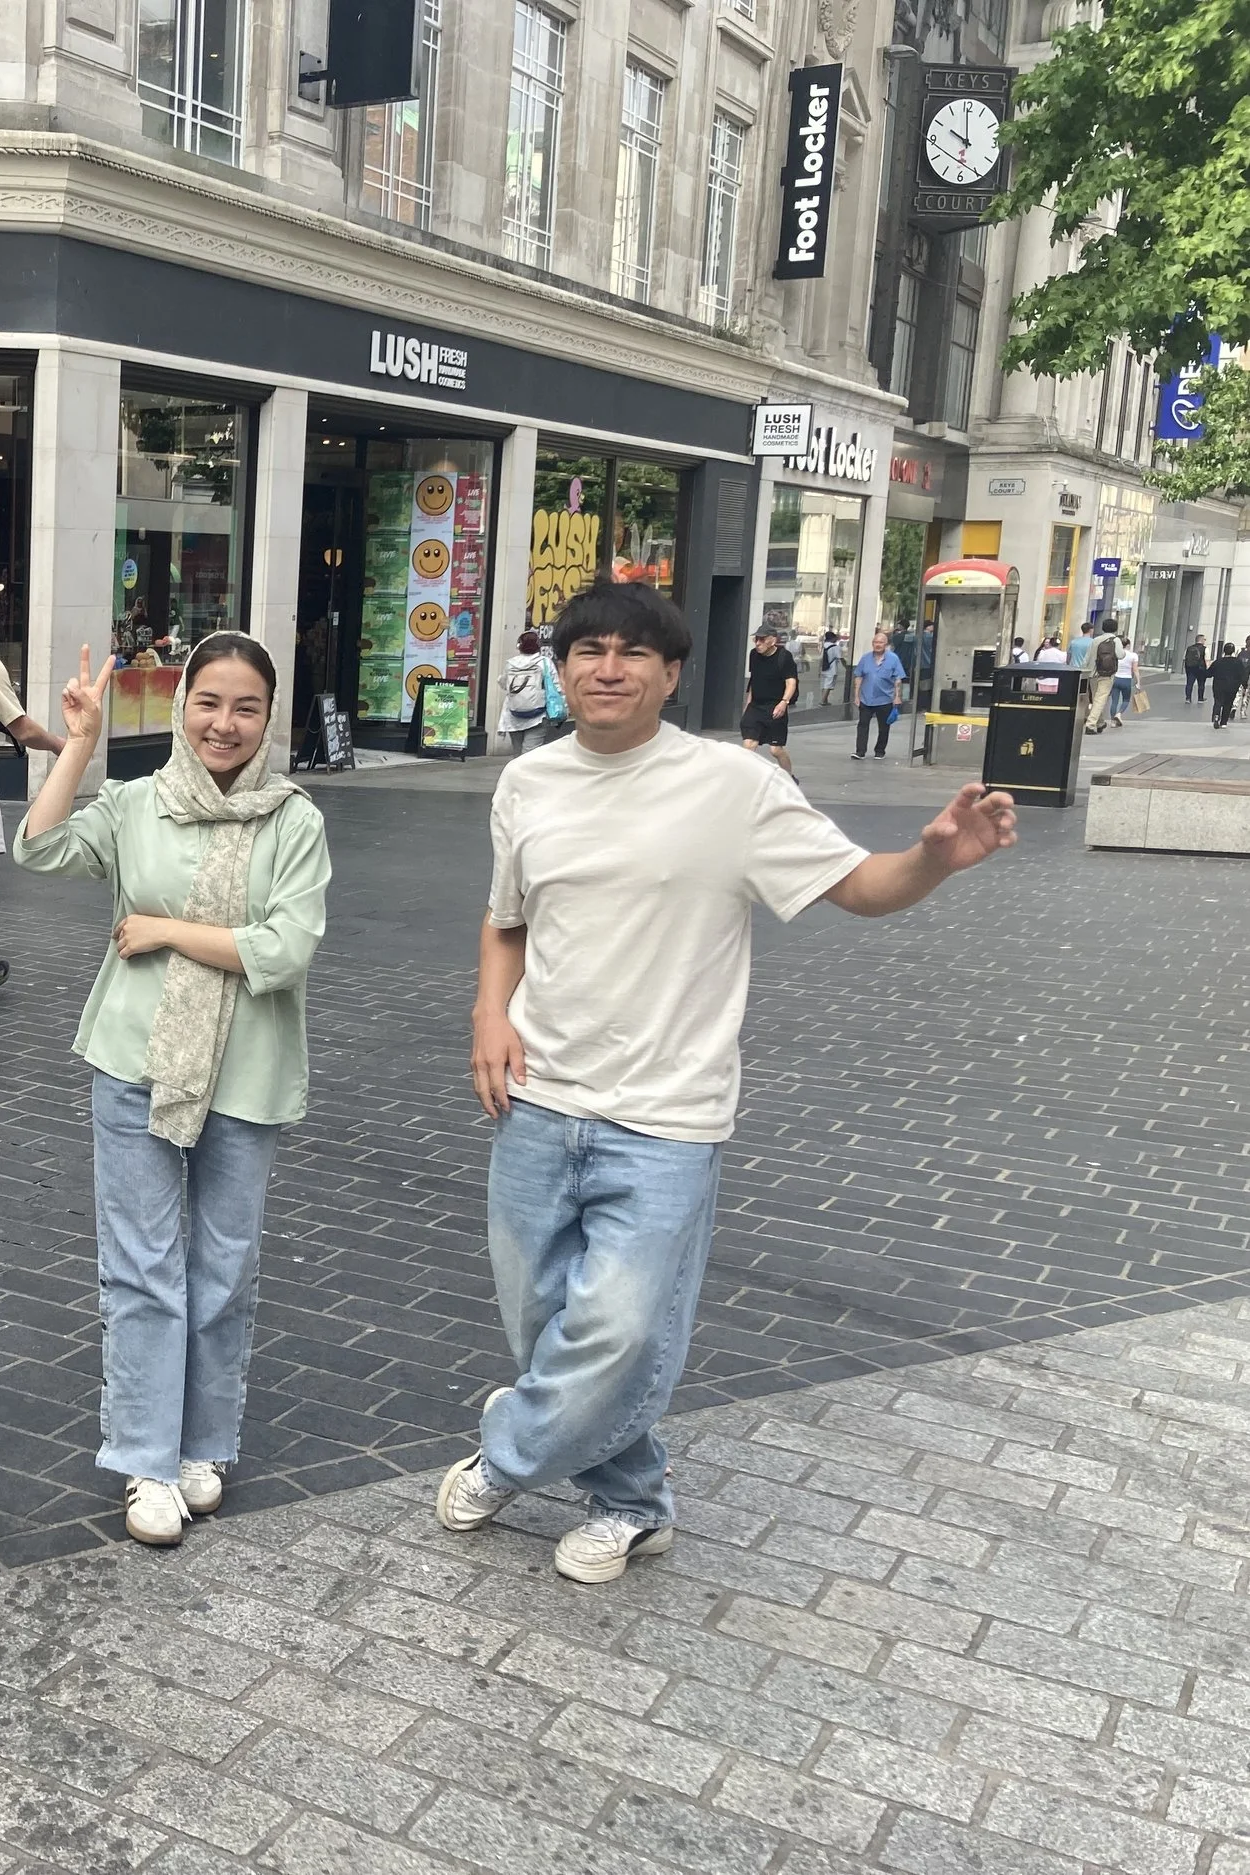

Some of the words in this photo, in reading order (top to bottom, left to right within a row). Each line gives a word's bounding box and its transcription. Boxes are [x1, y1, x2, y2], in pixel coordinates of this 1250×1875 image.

[944, 72, 990, 89] KEYS
[963, 101, 973, 113] 12
[794, 83, 830, 188] Locker
[956, 170, 964, 182] 6
[925, 195, 987, 211] COURT
[788, 194, 821, 263] Foot
[370, 330, 439, 385] LUSH
[439, 346, 468, 368] FRESH
[764, 413, 802, 424] LUSH
[763, 424, 800, 434] FRESH
[828, 427, 878, 482] Locker
[533, 508, 600, 573] LUSH
